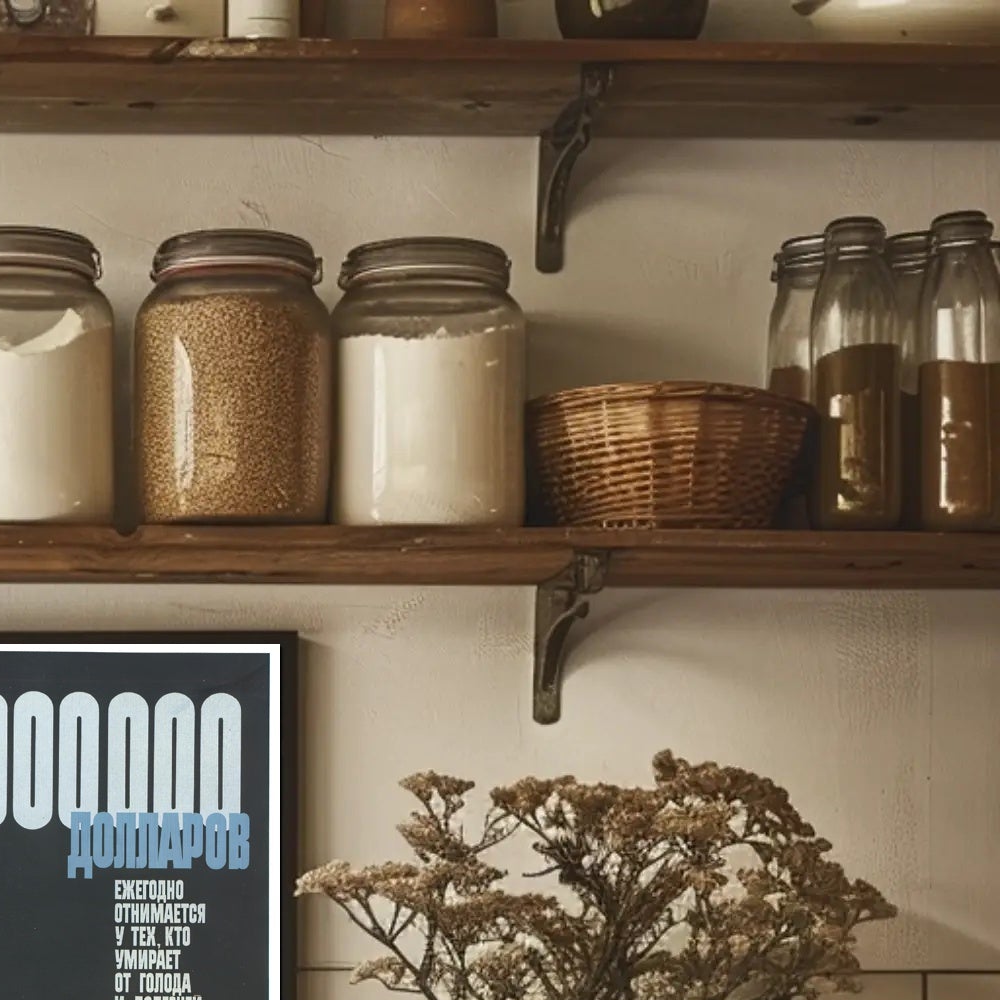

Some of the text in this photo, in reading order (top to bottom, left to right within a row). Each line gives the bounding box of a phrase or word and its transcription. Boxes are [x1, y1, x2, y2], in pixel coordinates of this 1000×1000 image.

[67, 811, 250, 879] ДОЛЛАРОВ
[114, 879, 184, 903] ЕЖЕГОДНО
[114, 903, 206, 924] ОТНИМАЕТСЯ
[115, 926, 191, 948] У ТЕХ, КТО
[115, 949, 181, 970] УМИРАЕТ
[114, 973, 191, 996] ОТ ГОЛОДА
